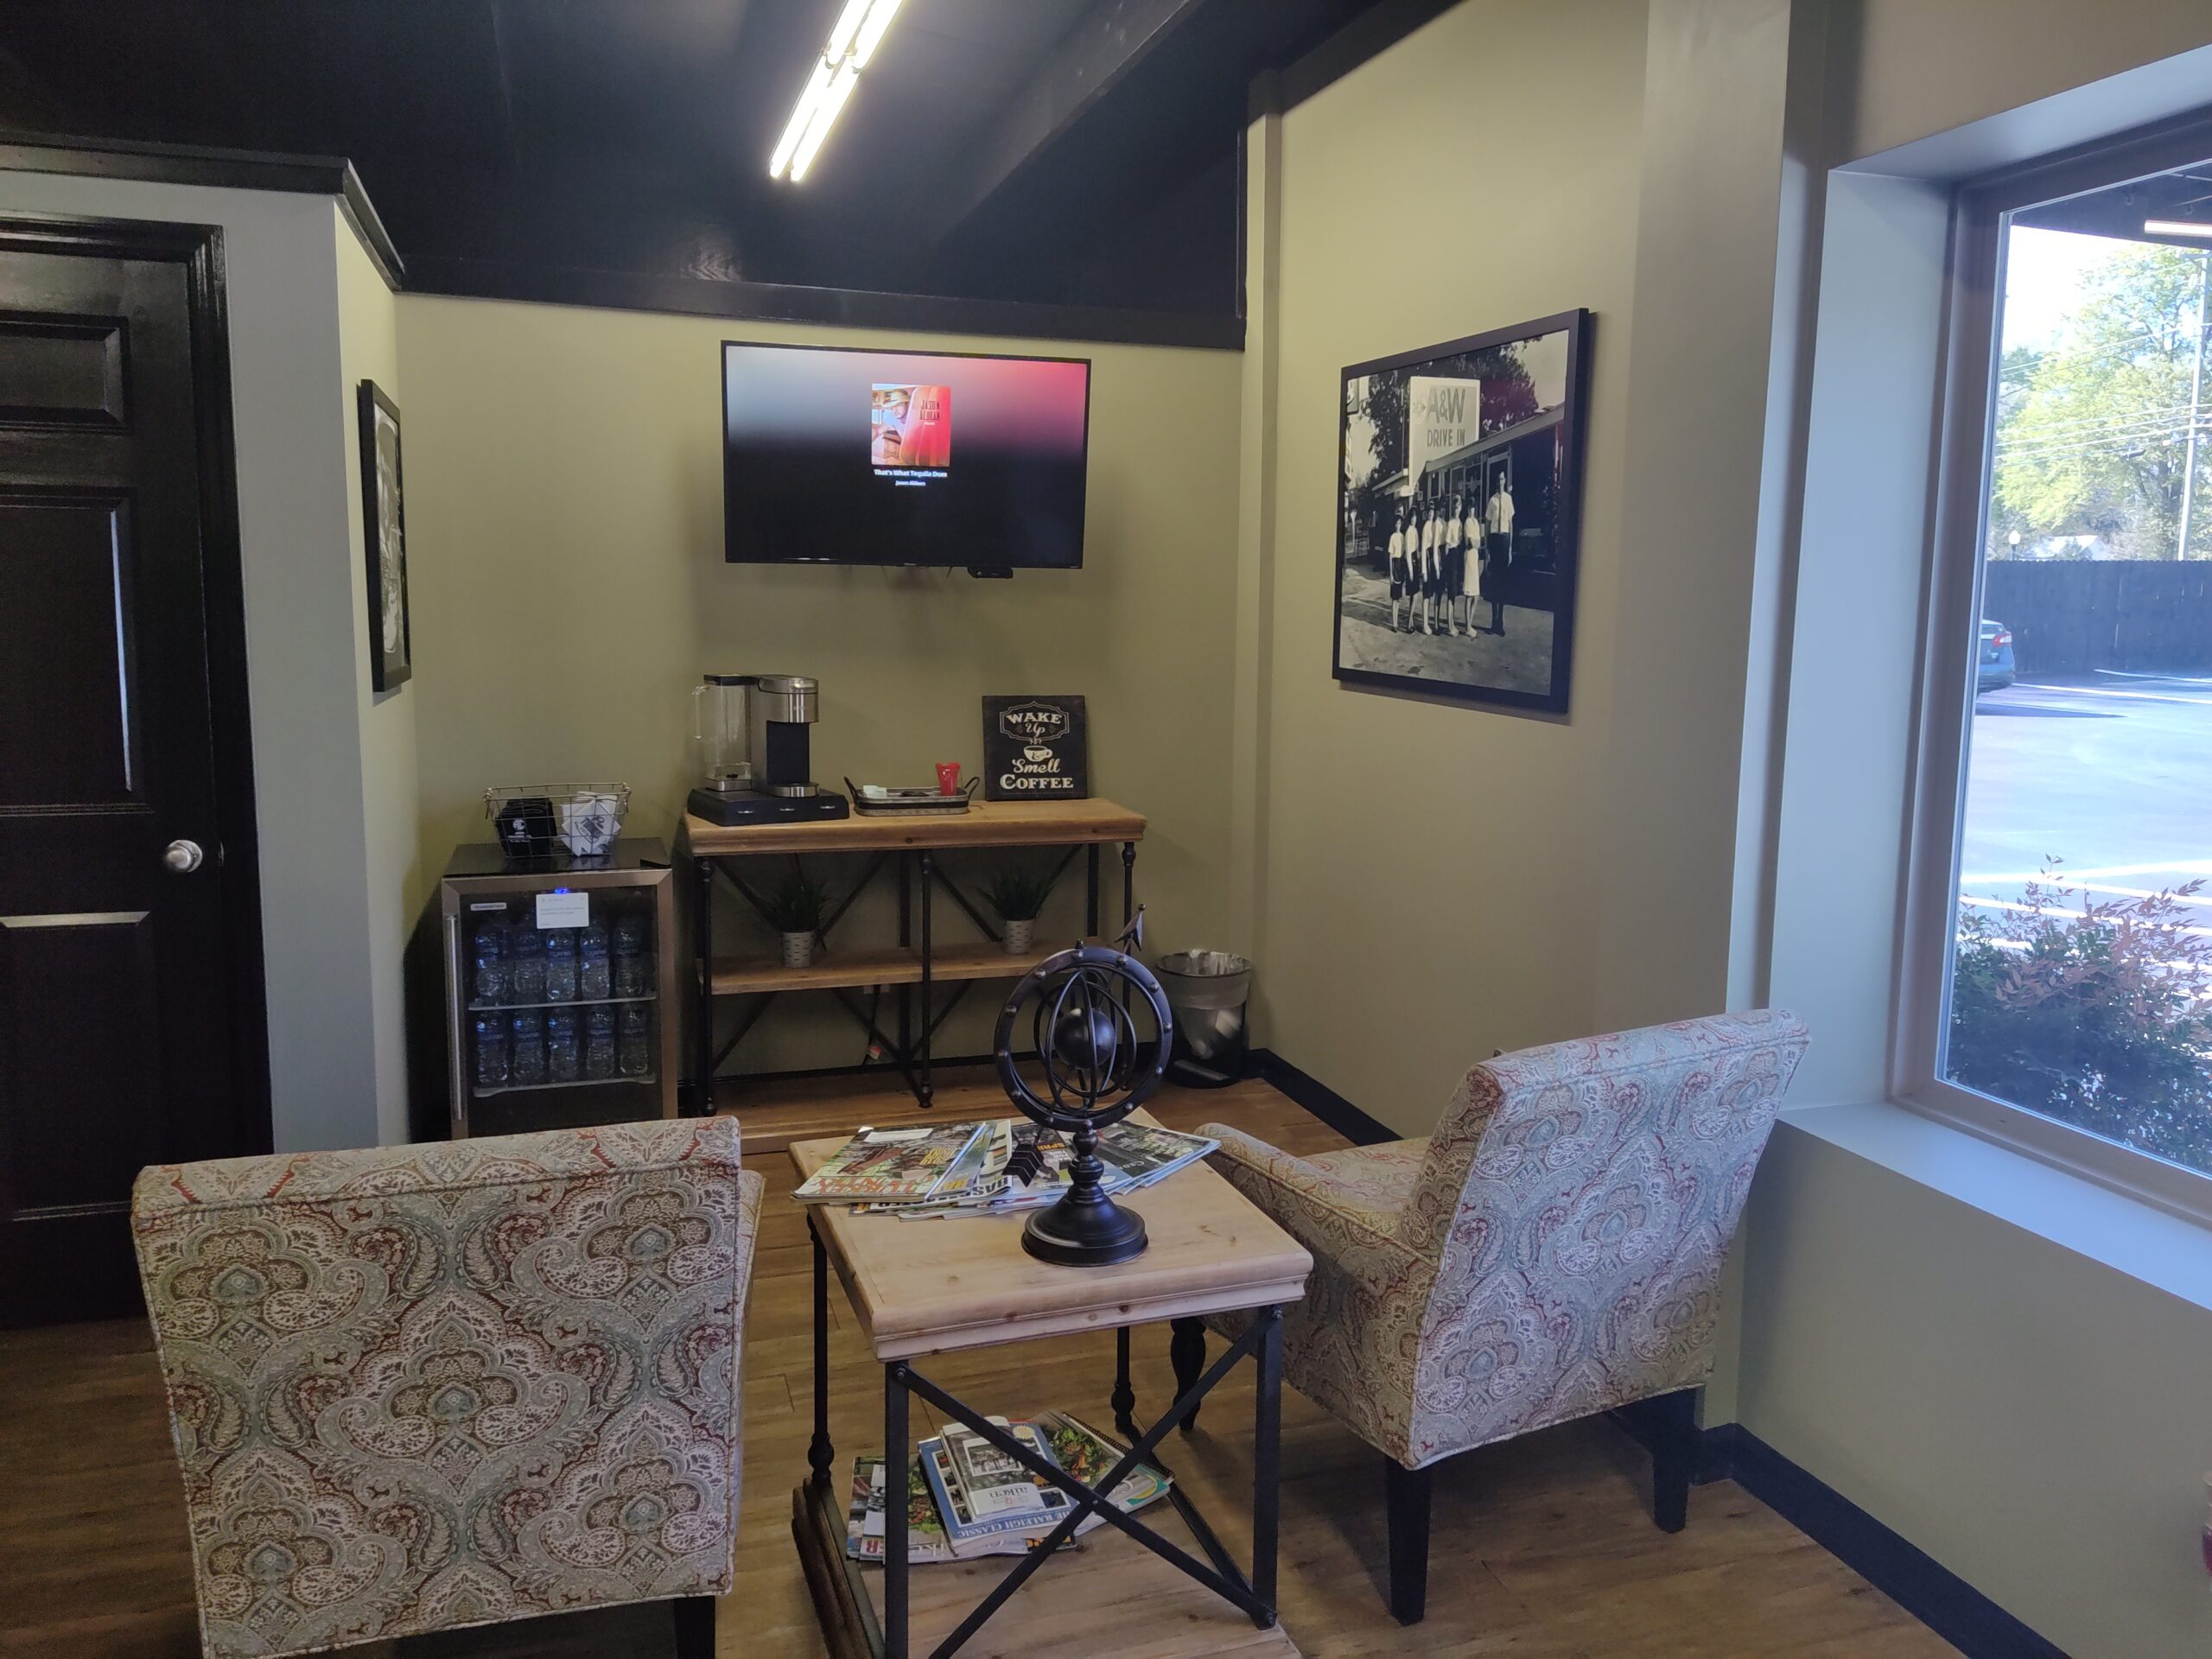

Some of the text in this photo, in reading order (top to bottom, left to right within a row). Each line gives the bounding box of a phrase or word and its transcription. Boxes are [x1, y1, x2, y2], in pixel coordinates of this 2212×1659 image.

[1428, 387, 1466, 423] A&W
[1427, 429, 1465, 448] DRIVE IN
[1006, 712, 1062, 724] WAKE
[1025, 722, 1046, 738] Up
[1012, 759, 1060, 773] Smell
[1000, 774, 1074, 790] COFFEE
[989, 1487, 1028, 1499] aiken
[957, 1511, 1071, 1538] HE RALEIGH CLASSIC
